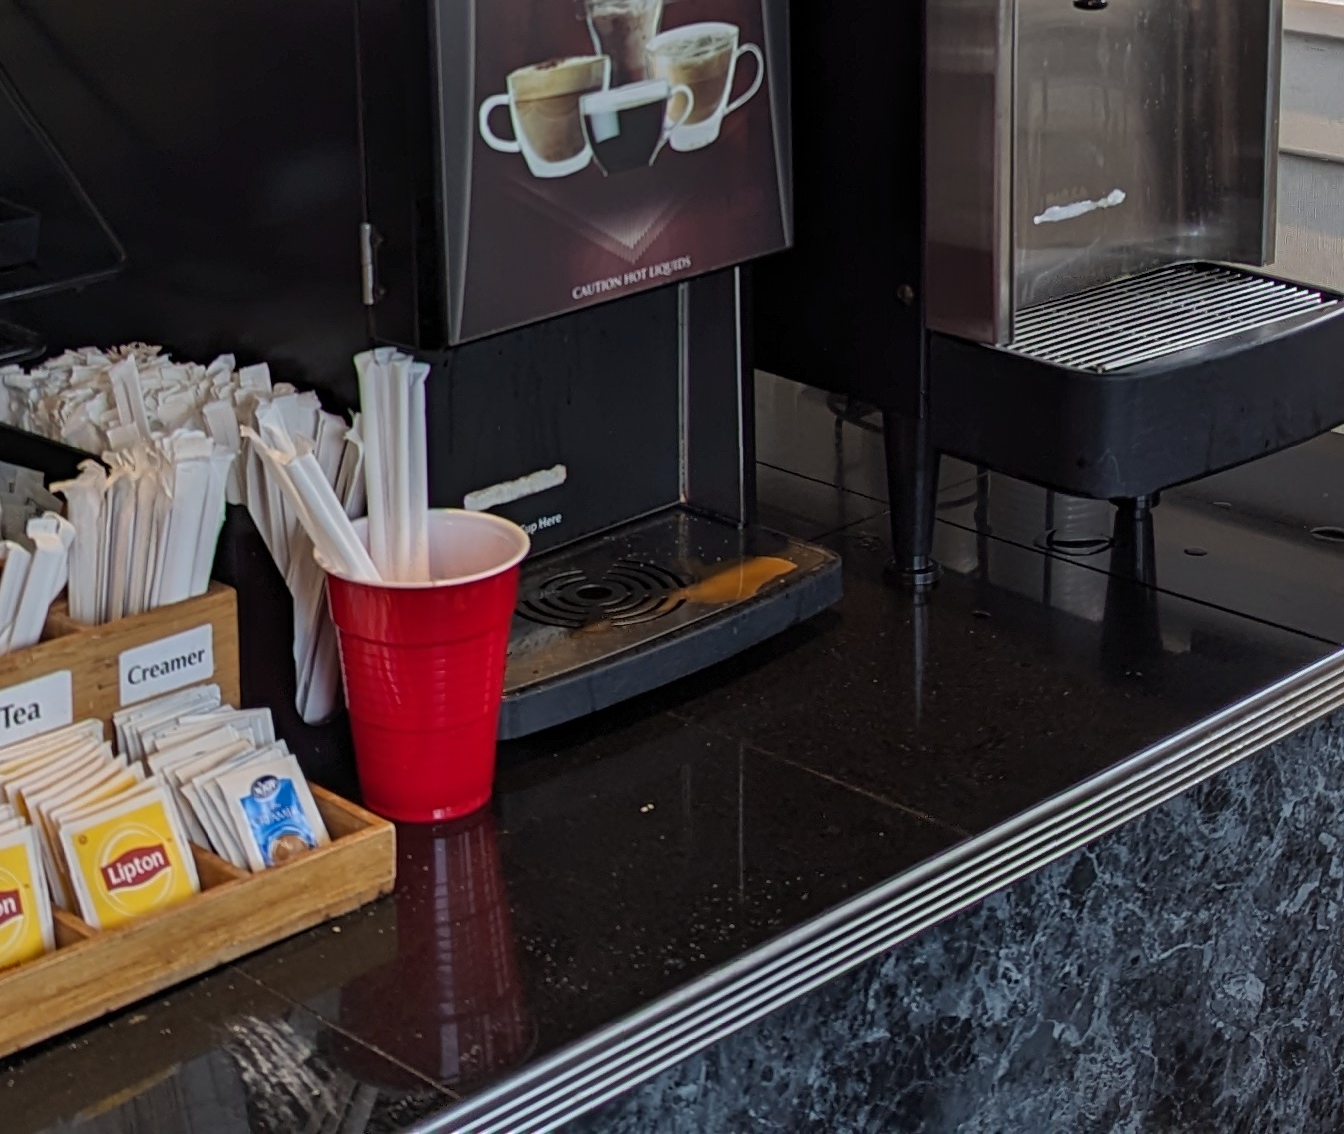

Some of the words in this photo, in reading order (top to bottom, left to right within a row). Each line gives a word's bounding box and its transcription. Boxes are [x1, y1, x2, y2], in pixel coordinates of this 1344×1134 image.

[571, 277, 623, 301] CAUTION
[623, 268, 649, 287] HOT
[648, 255, 692, 279] LIQUIDS
[538, 513, 563, 529] Here
[126, 647, 206, 686] Creamer
[106, 851, 165, 885] Lipton
